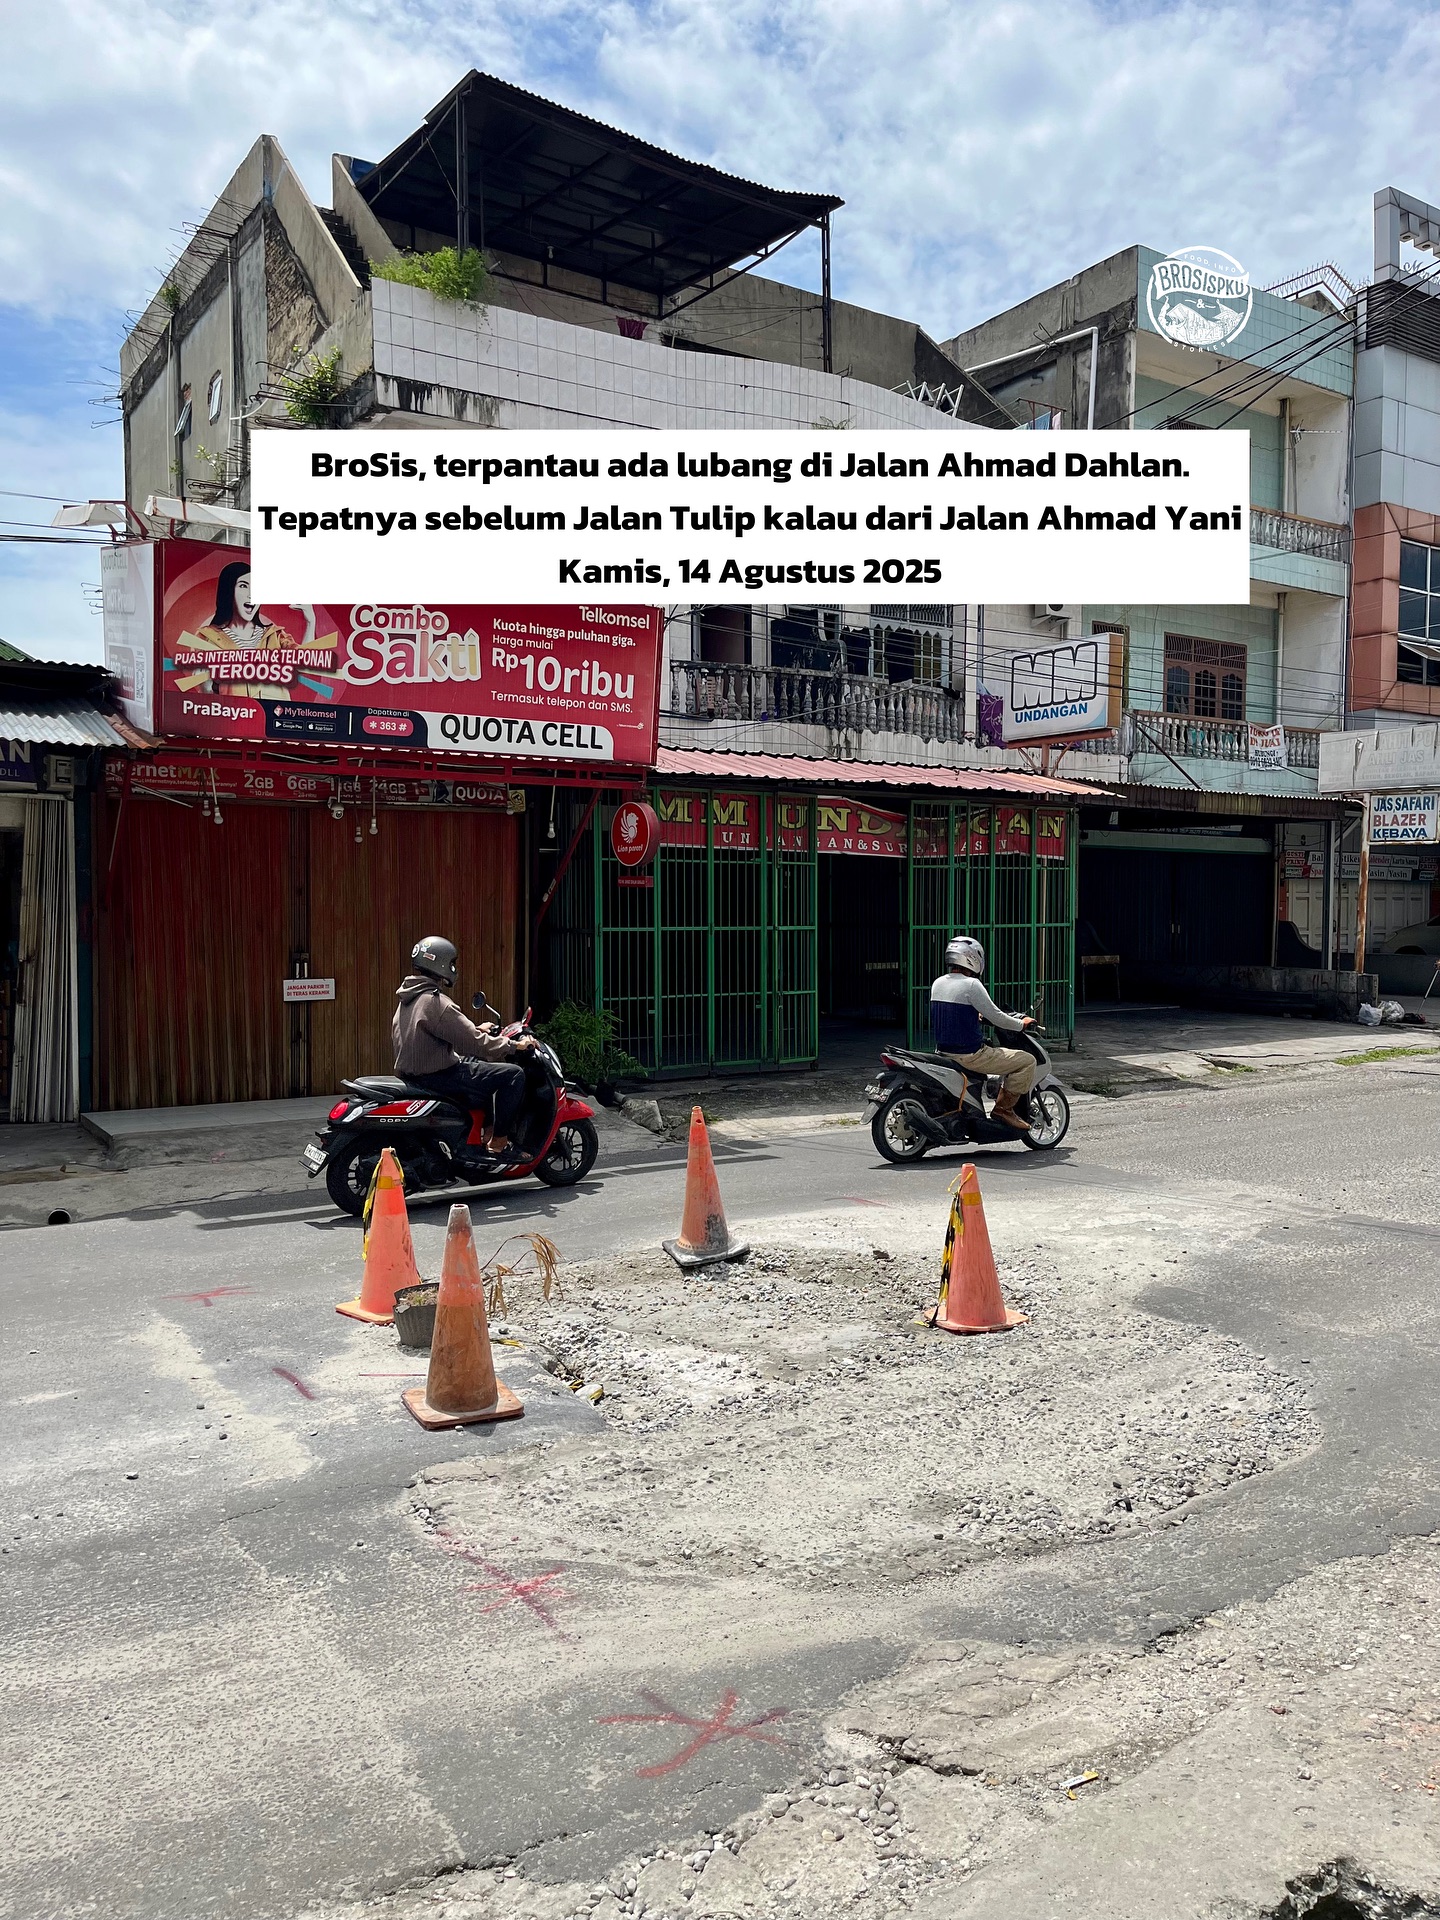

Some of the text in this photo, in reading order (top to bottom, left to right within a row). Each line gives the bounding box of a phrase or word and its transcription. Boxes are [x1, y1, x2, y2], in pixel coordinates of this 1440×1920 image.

[355, 604, 445, 630] Combo
[579, 606, 650, 629] Telkomsel
[493, 618, 636, 648] Kuota hingga puluhan giga.
[493, 635, 553, 650] Harga mulai
[175, 650, 333, 668] PUAS INTERNETAN & TELPONAN
[347, 629, 479, 680] Sakti
[208, 664, 293, 682] TEROOSS
[1011, 642, 1098, 711] MM
[183, 700, 256, 720] PraBayar
[491, 690, 633, 713] Termasuk telepon dan SMS.
[285, 706, 337, 719] MyTelkomsel
[367, 708, 401, 717] Dapatkan
[1015, 702, 1088, 723] UNDANGAN
[380, 722, 396, 731] 363
[440, 714, 603, 750] QUOTA CELL
[1400, 751, 1424, 764] JAS
[244, 774, 274, 789] 2GB
[287, 776, 317, 791] 6GB
[455, 786, 504, 801] QUOTA
[1373, 813, 1427, 827] BLAZER
[1373, 828, 1428, 838] KEBAYA
[617, 843, 643, 854] Lion parcel
[1390, 870, 1408, 878] Yasin
